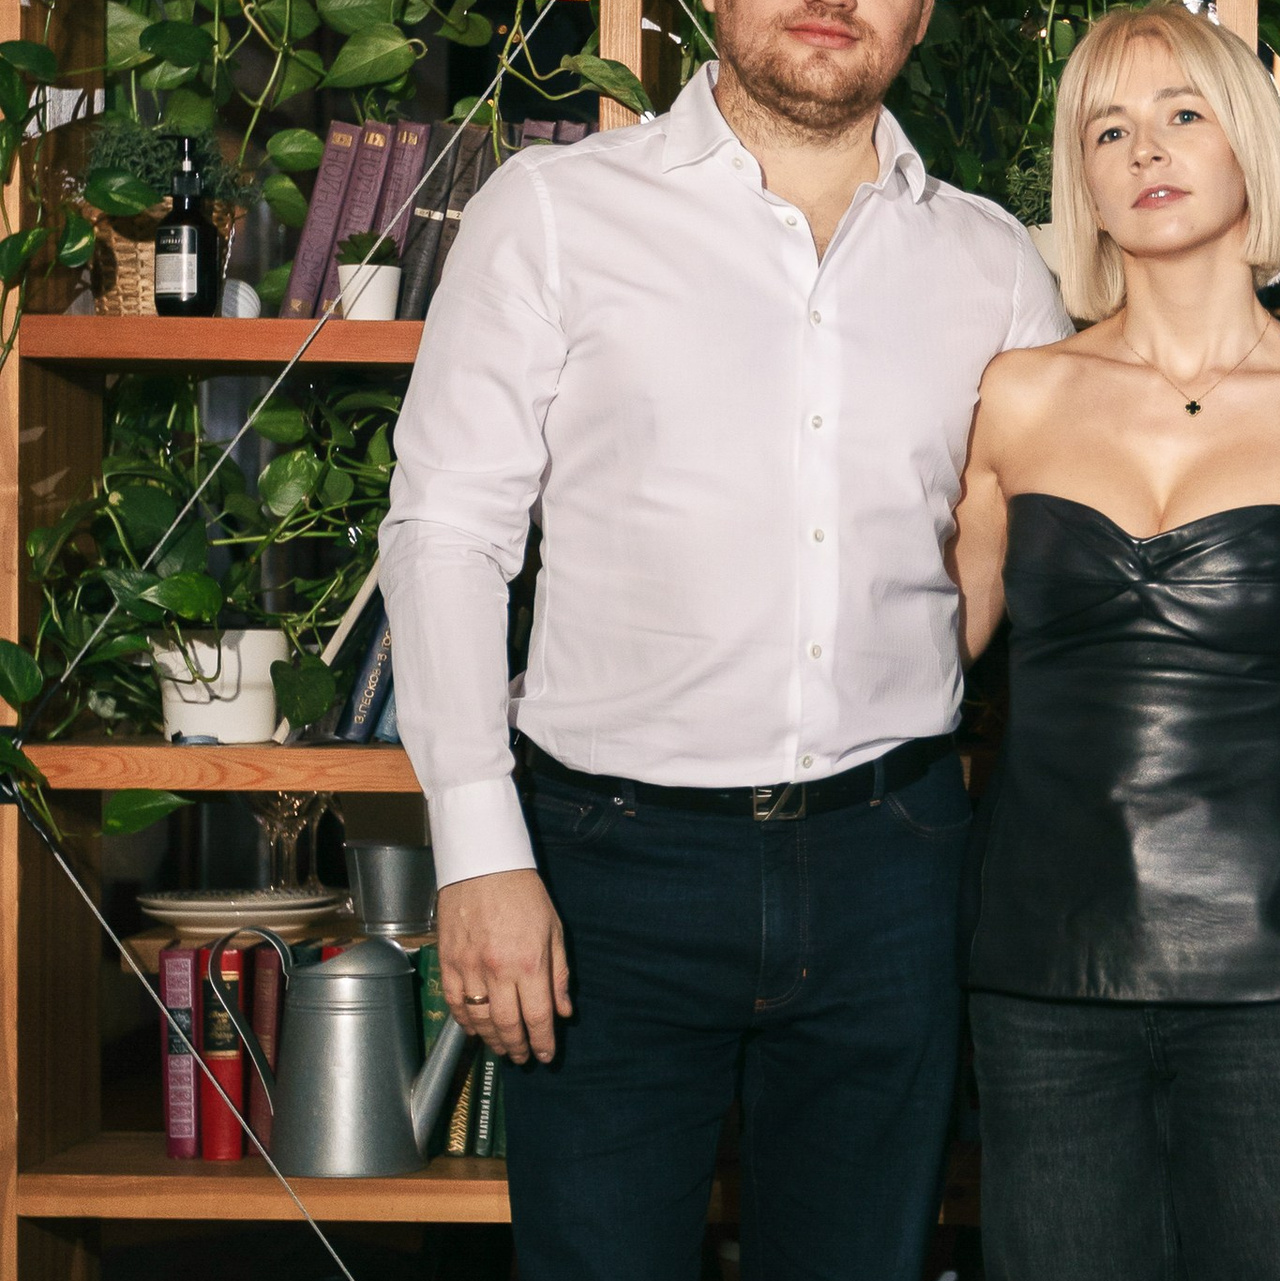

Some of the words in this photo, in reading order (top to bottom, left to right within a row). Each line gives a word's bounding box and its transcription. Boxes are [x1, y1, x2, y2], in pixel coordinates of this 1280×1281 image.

[308, 147, 350, 234] ЛОНДОН
[298, 239, 326, 296] ДЖЕК
[482, 1060, 495, 1096] АНАНЬЕВ
[478, 1098, 491, 1140] АНАТОЛИЙ
